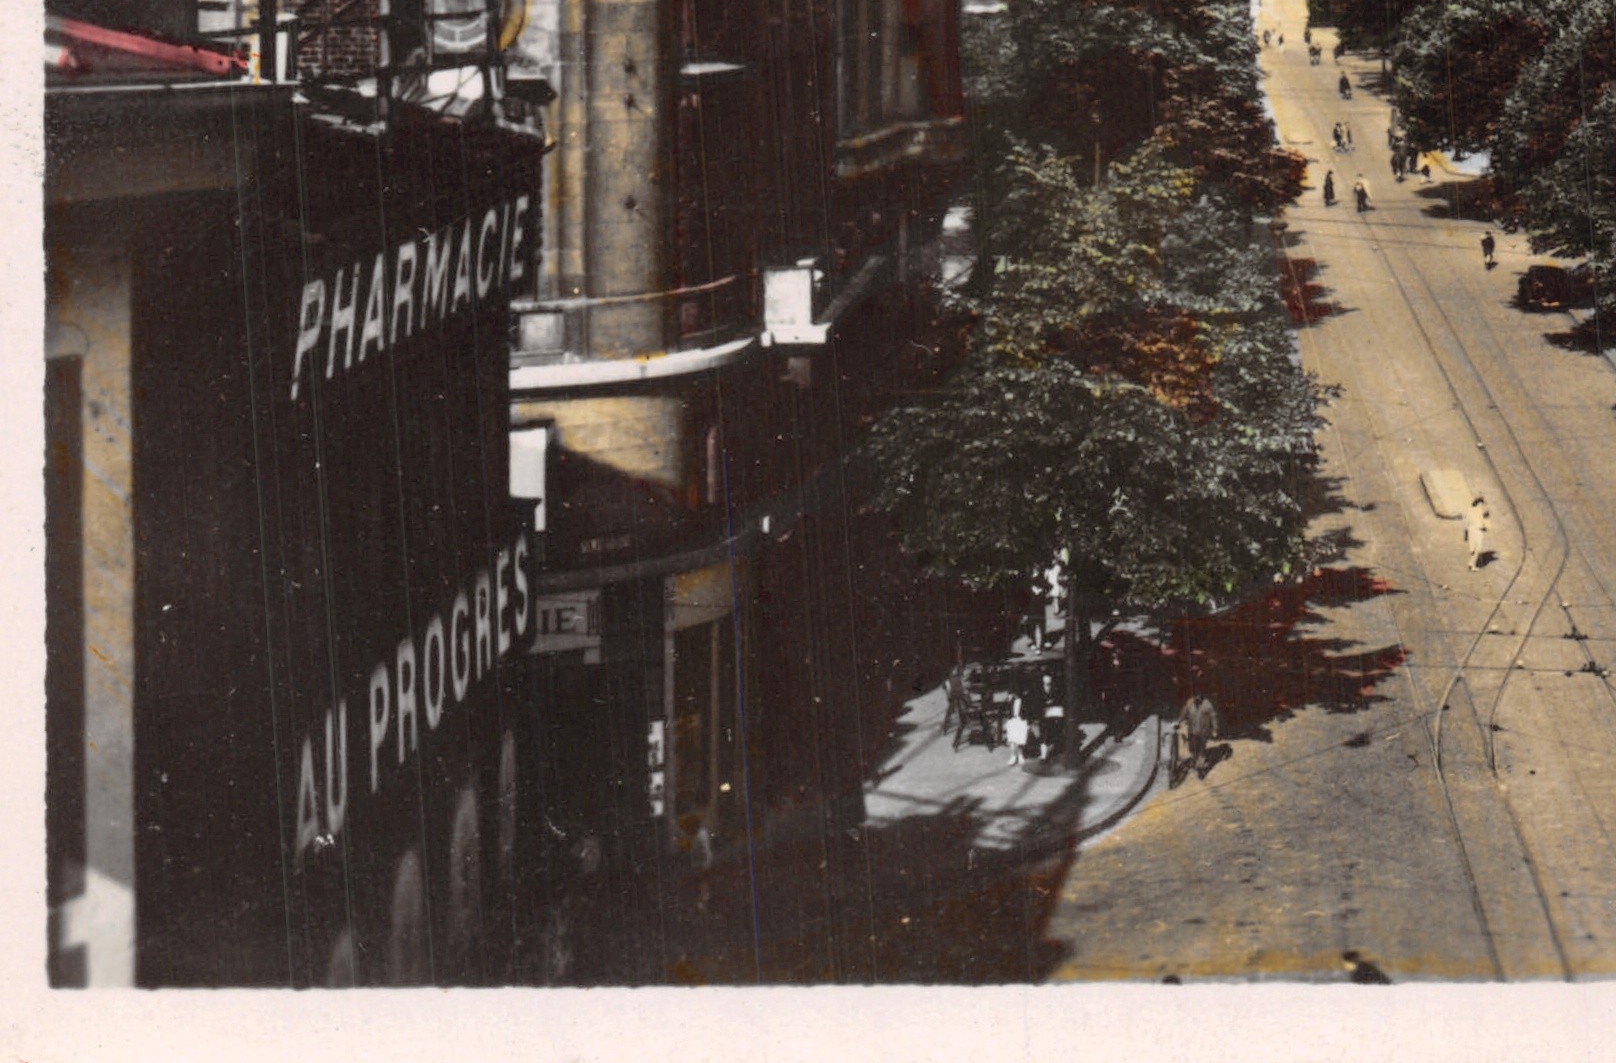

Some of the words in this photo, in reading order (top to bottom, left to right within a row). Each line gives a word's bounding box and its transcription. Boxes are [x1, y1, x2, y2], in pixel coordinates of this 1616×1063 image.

[290, 195, 529, 401] PHARMACIE
[293, 698, 348, 868] AU
[370, 532, 529, 794] PROGRES
